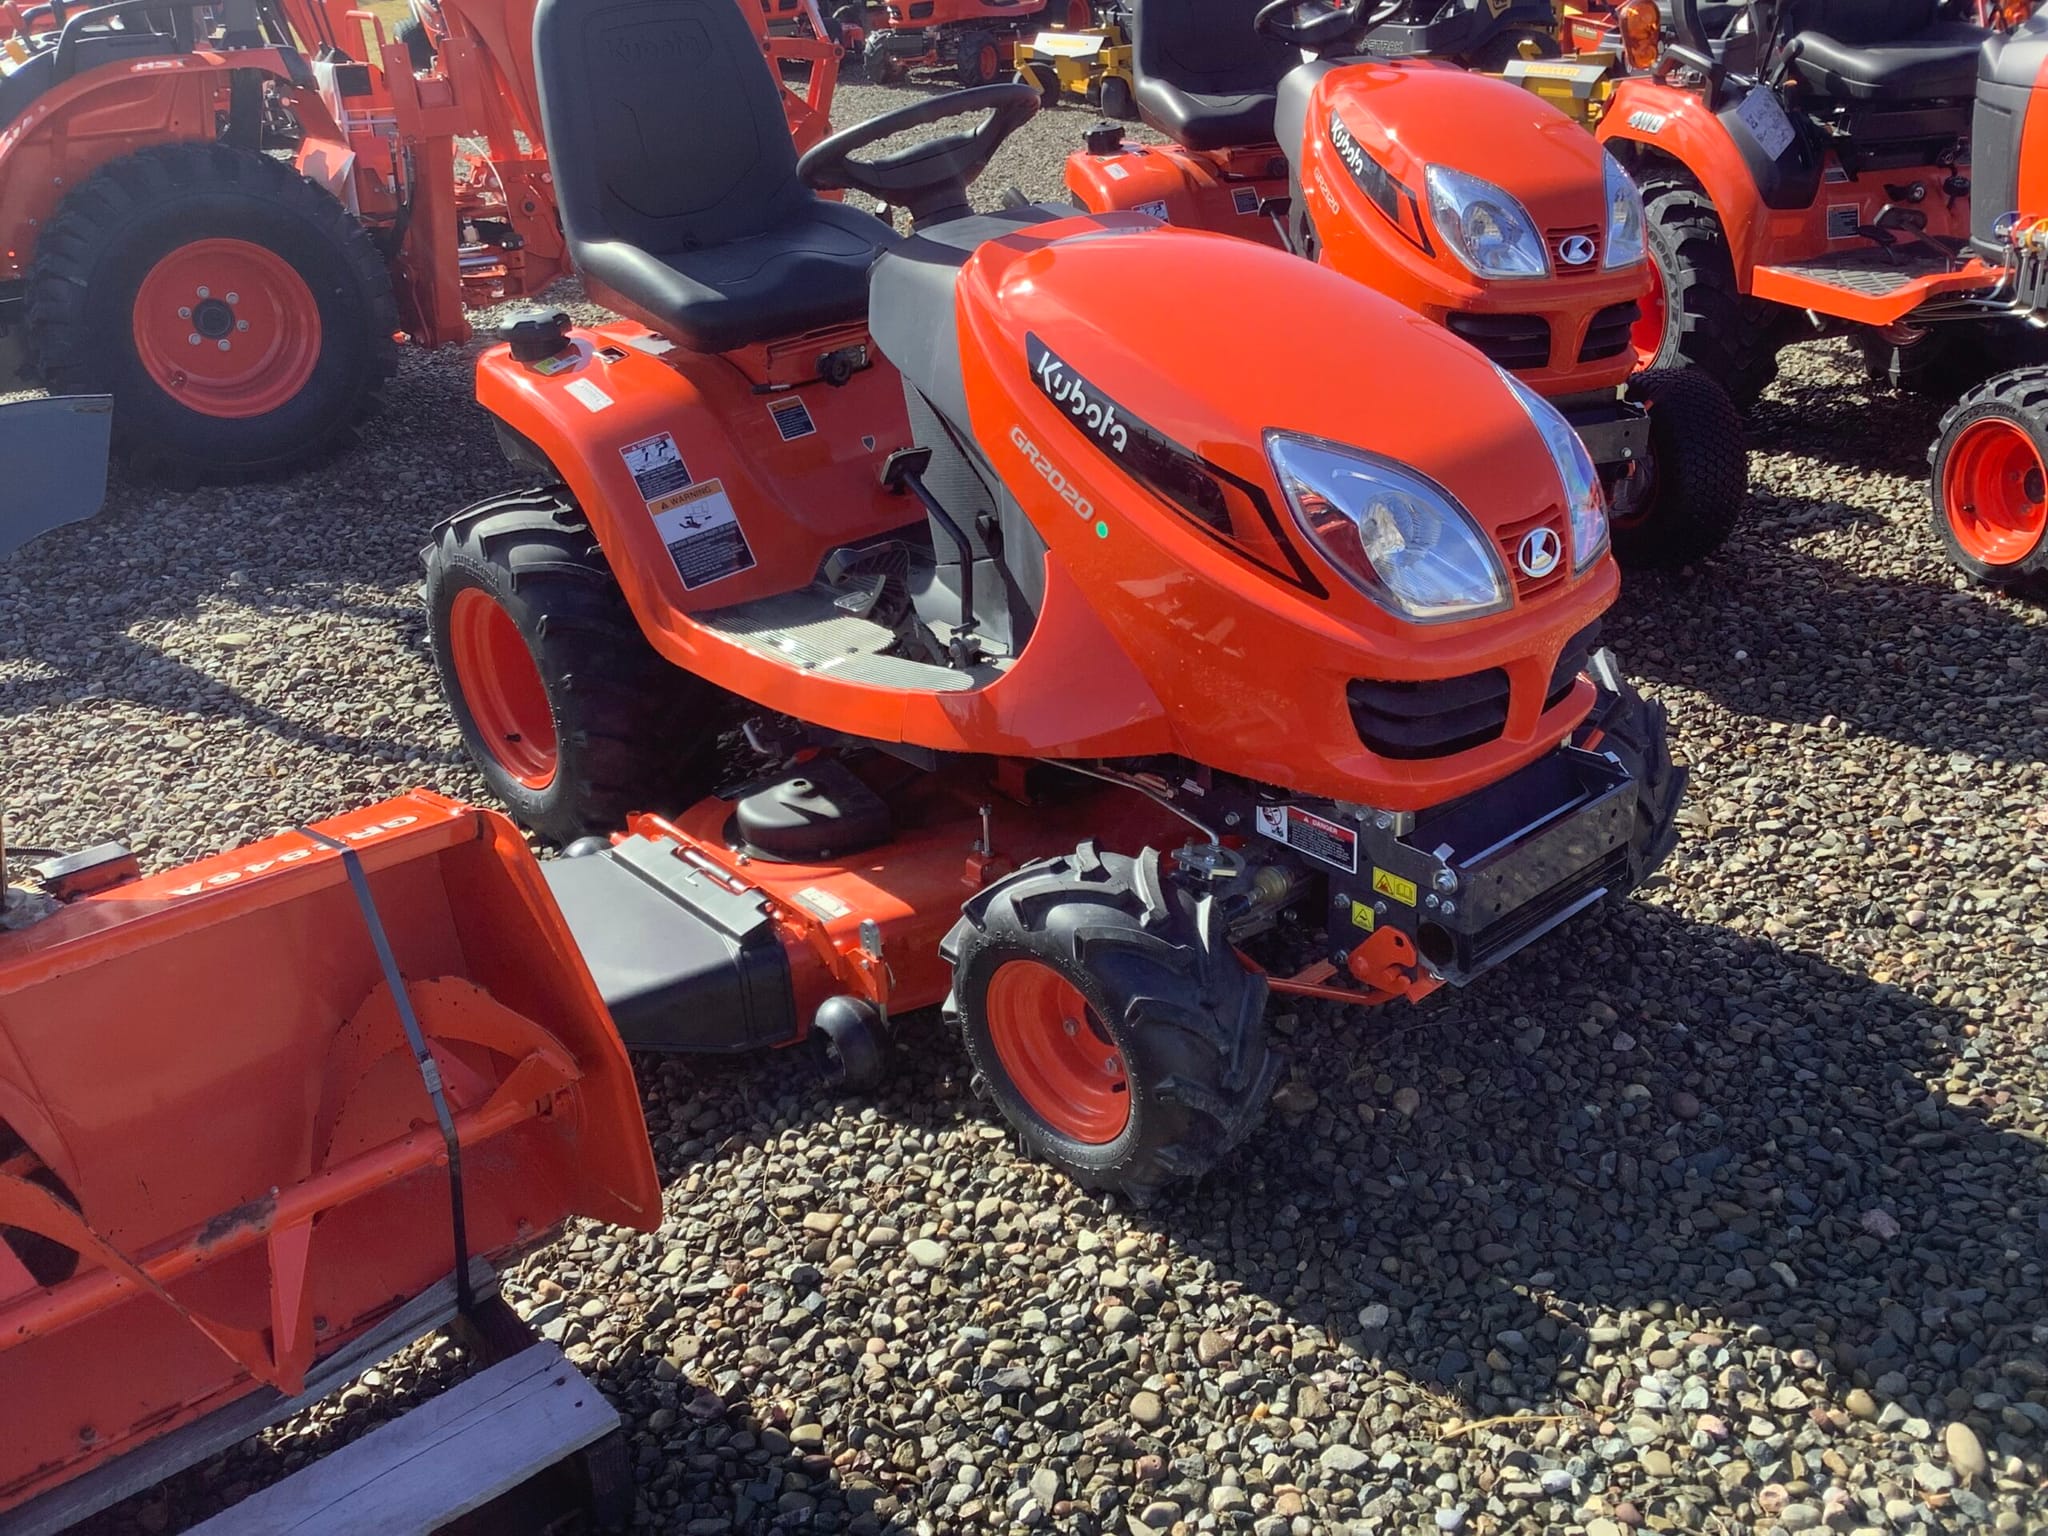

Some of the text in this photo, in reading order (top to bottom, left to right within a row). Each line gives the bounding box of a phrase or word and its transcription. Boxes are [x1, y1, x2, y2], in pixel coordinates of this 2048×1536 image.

[1627, 111, 1667, 134] 4WD
[1331, 117, 1363, 176] Kubota
[1037, 351, 1128, 453] Kubota
[1009, 425, 1095, 521] GR2020
[670, 485, 712, 506] WARNING
[1312, 816, 1339, 835] DANGER
